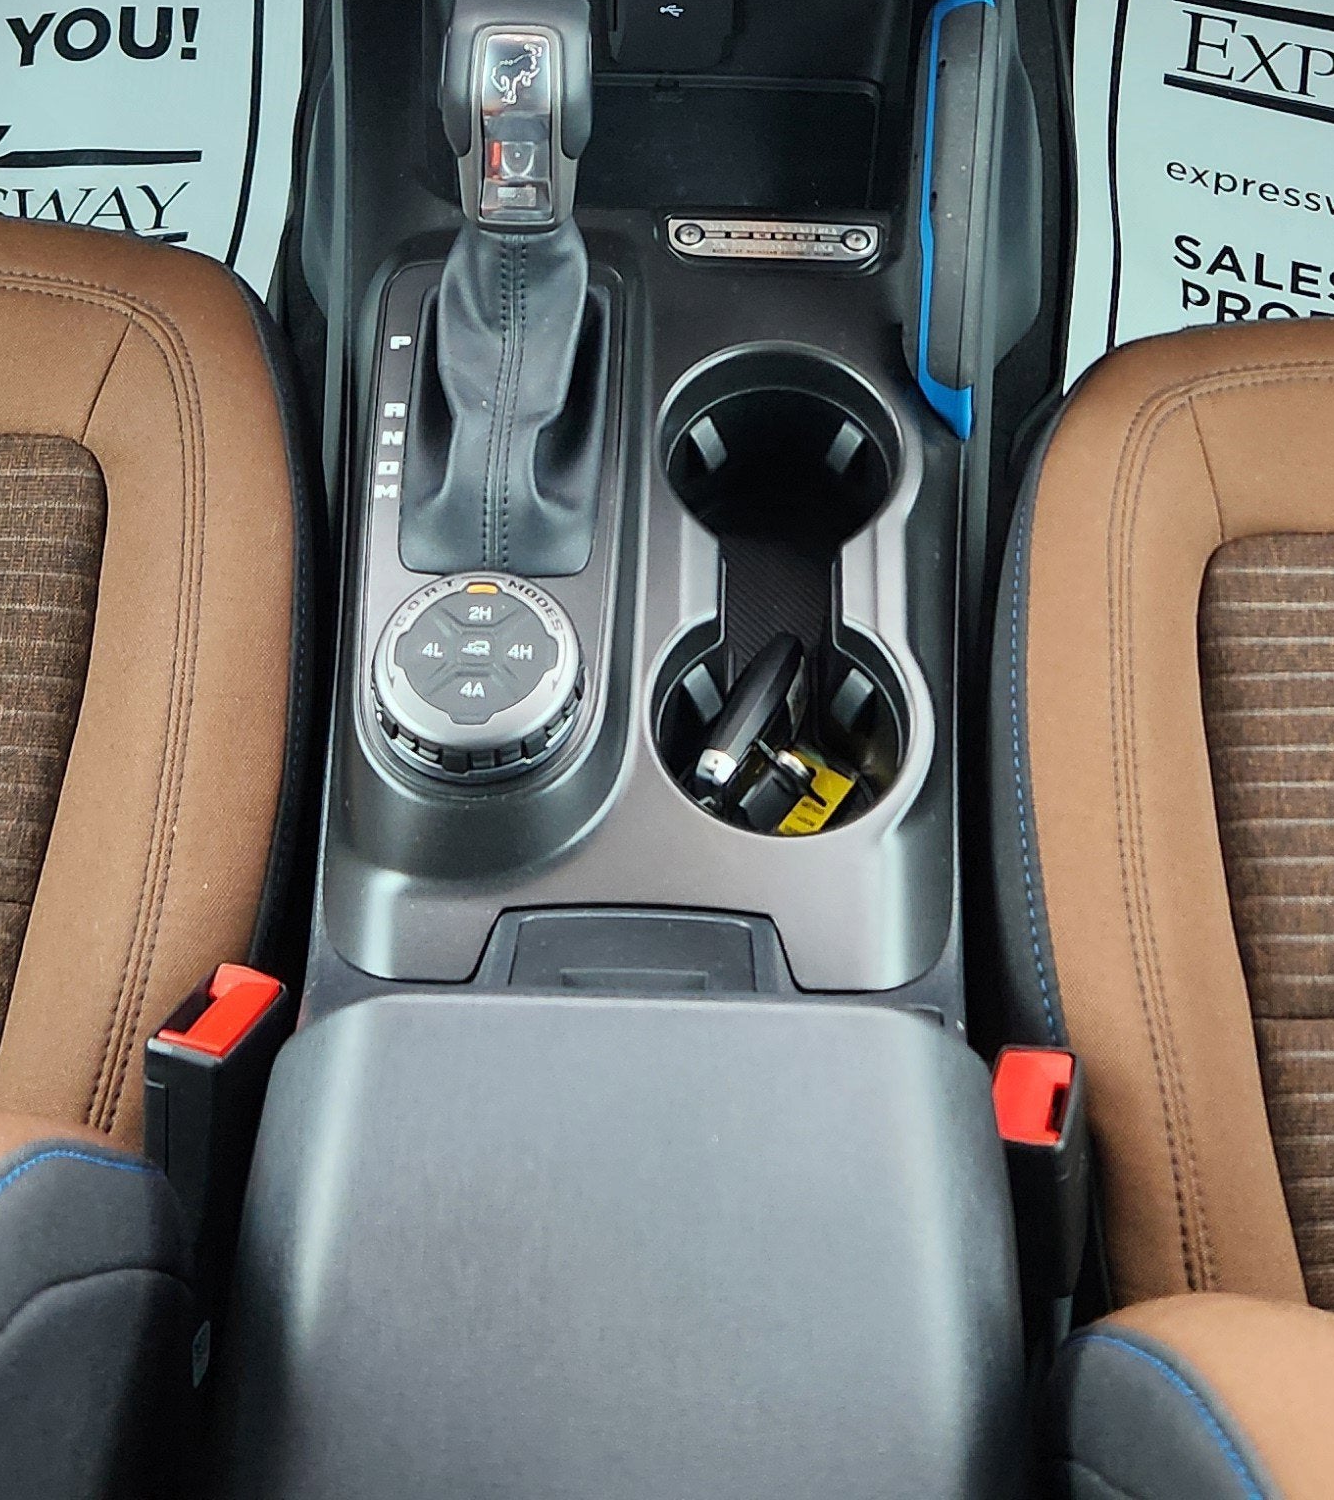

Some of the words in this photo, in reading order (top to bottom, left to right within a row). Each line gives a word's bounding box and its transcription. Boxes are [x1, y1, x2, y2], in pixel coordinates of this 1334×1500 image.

[6, 6, 201, 68] YOU!
[390, 336, 412, 350] P
[381, 431, 404, 445] N
[374, 484, 398, 498] M
[468, 606, 492, 620] 2H
[508, 580, 564, 631] MODES
[421, 643, 444, 658] 4L
[507, 644, 533, 660] 4H
[460, 682, 486, 698] 4A
